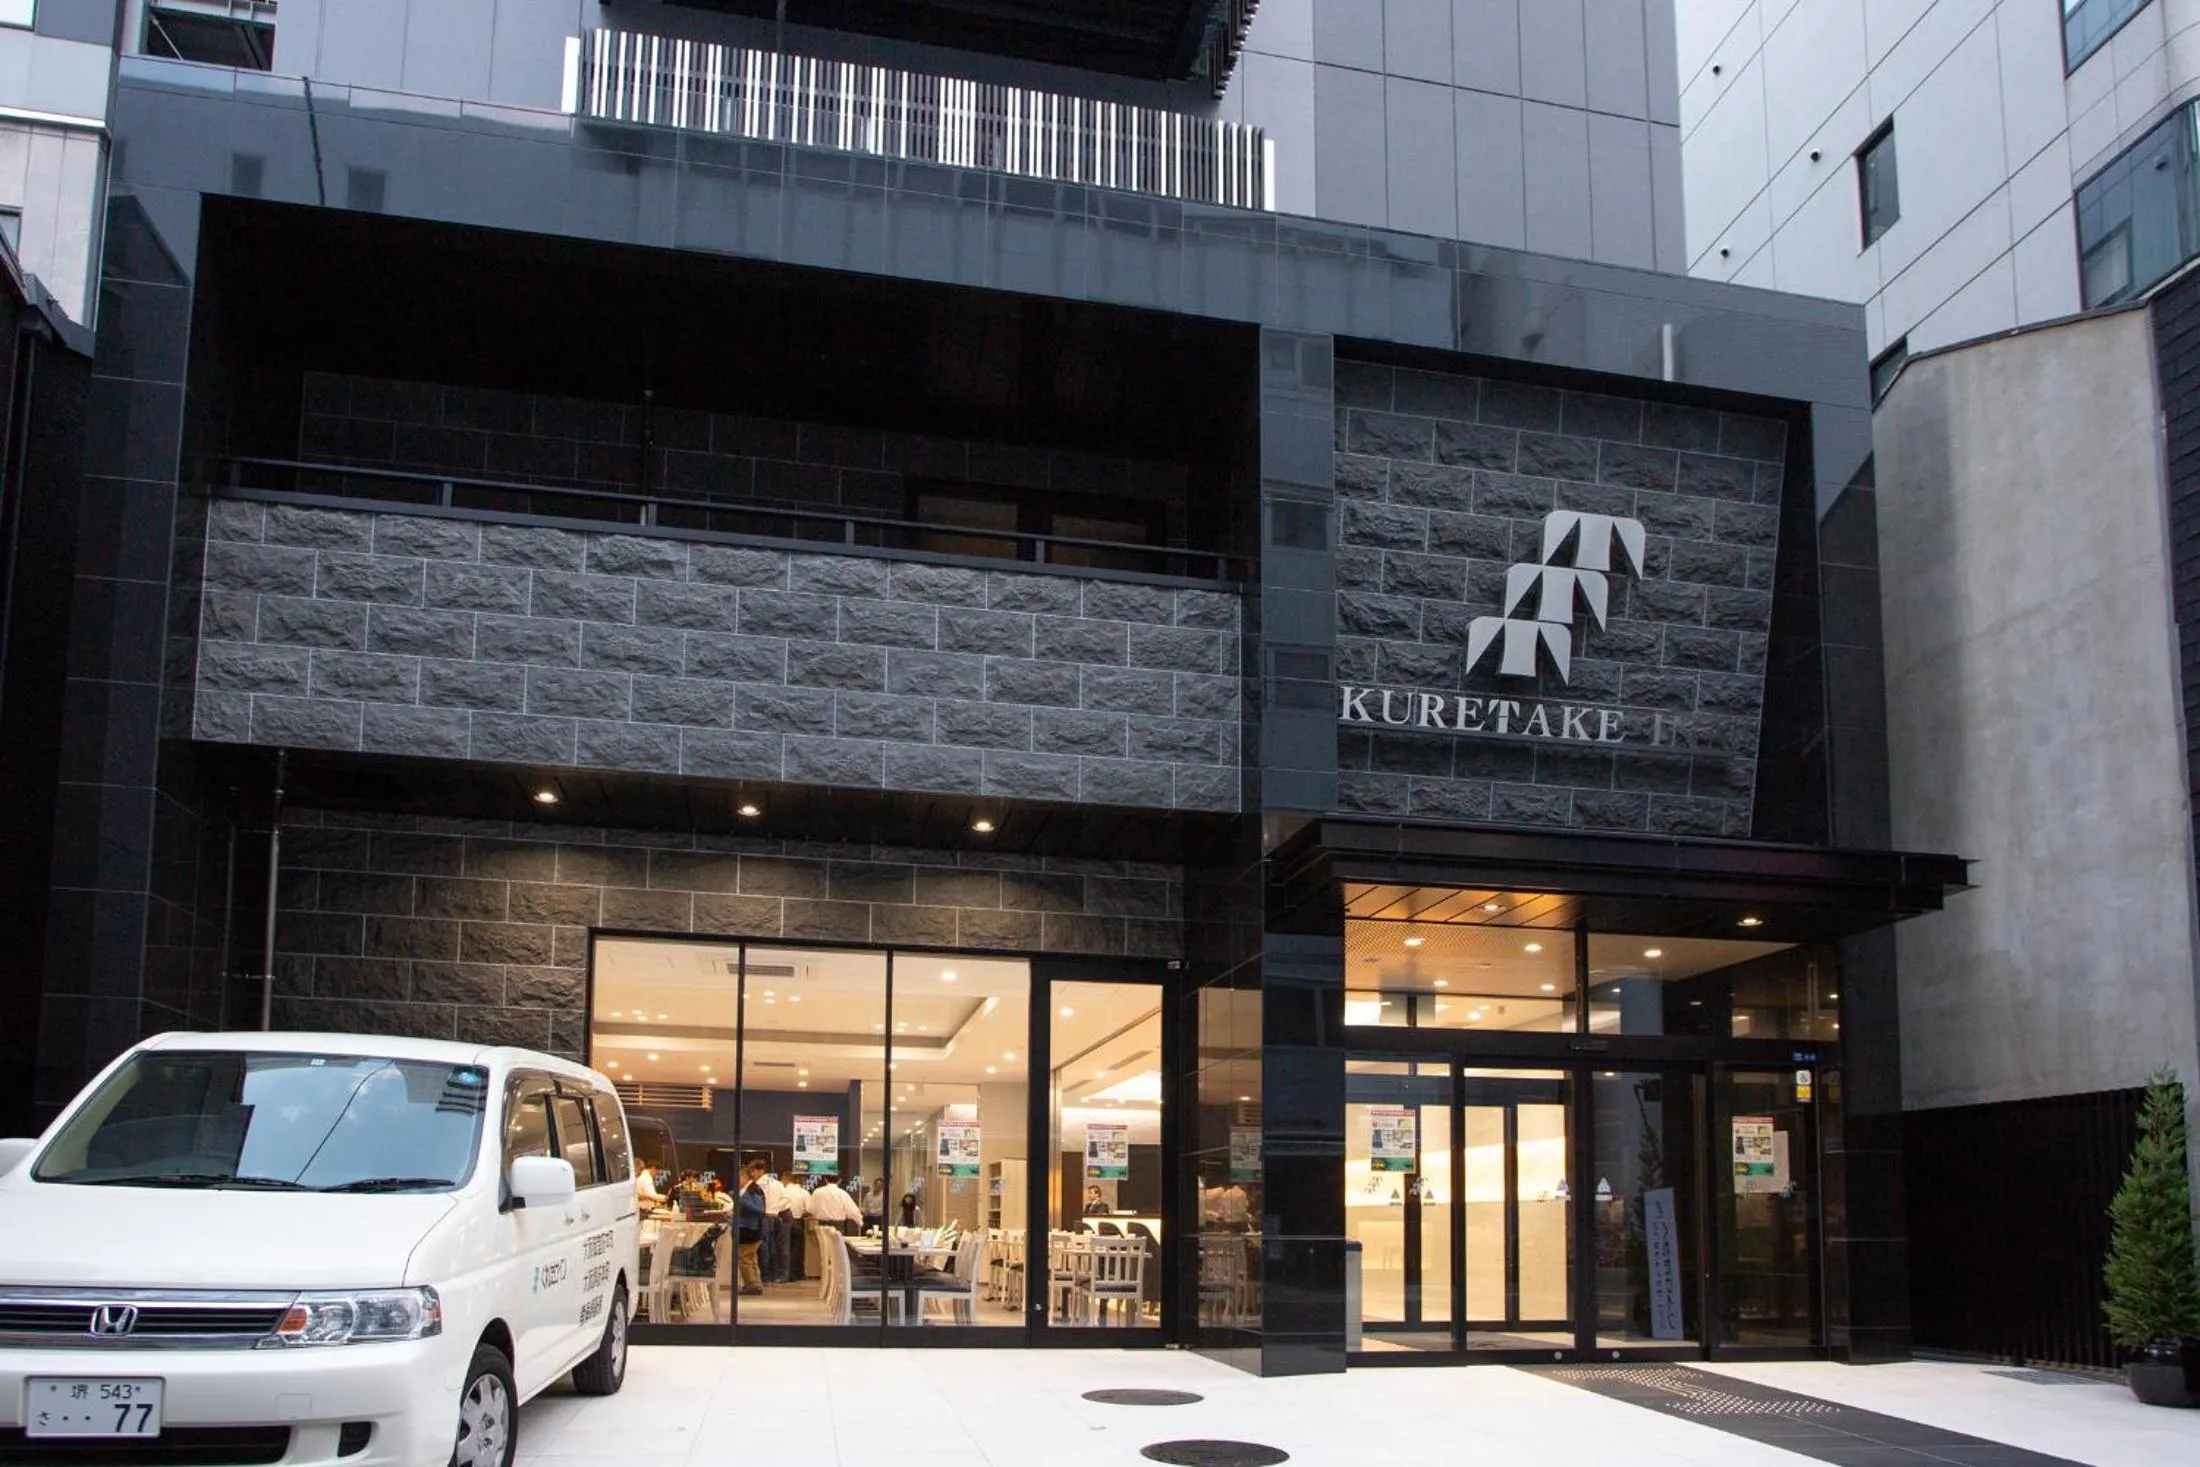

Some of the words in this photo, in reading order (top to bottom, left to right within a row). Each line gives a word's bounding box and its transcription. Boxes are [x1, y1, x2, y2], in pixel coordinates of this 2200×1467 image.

[1339, 685, 1625, 744] KURETAKE
[71, 1384, 89, 1400] 堺
[100, 1384, 132, 1399] 543
[38, 1410, 50, 1427] さ
[114, 1403, 153, 1433] 77
